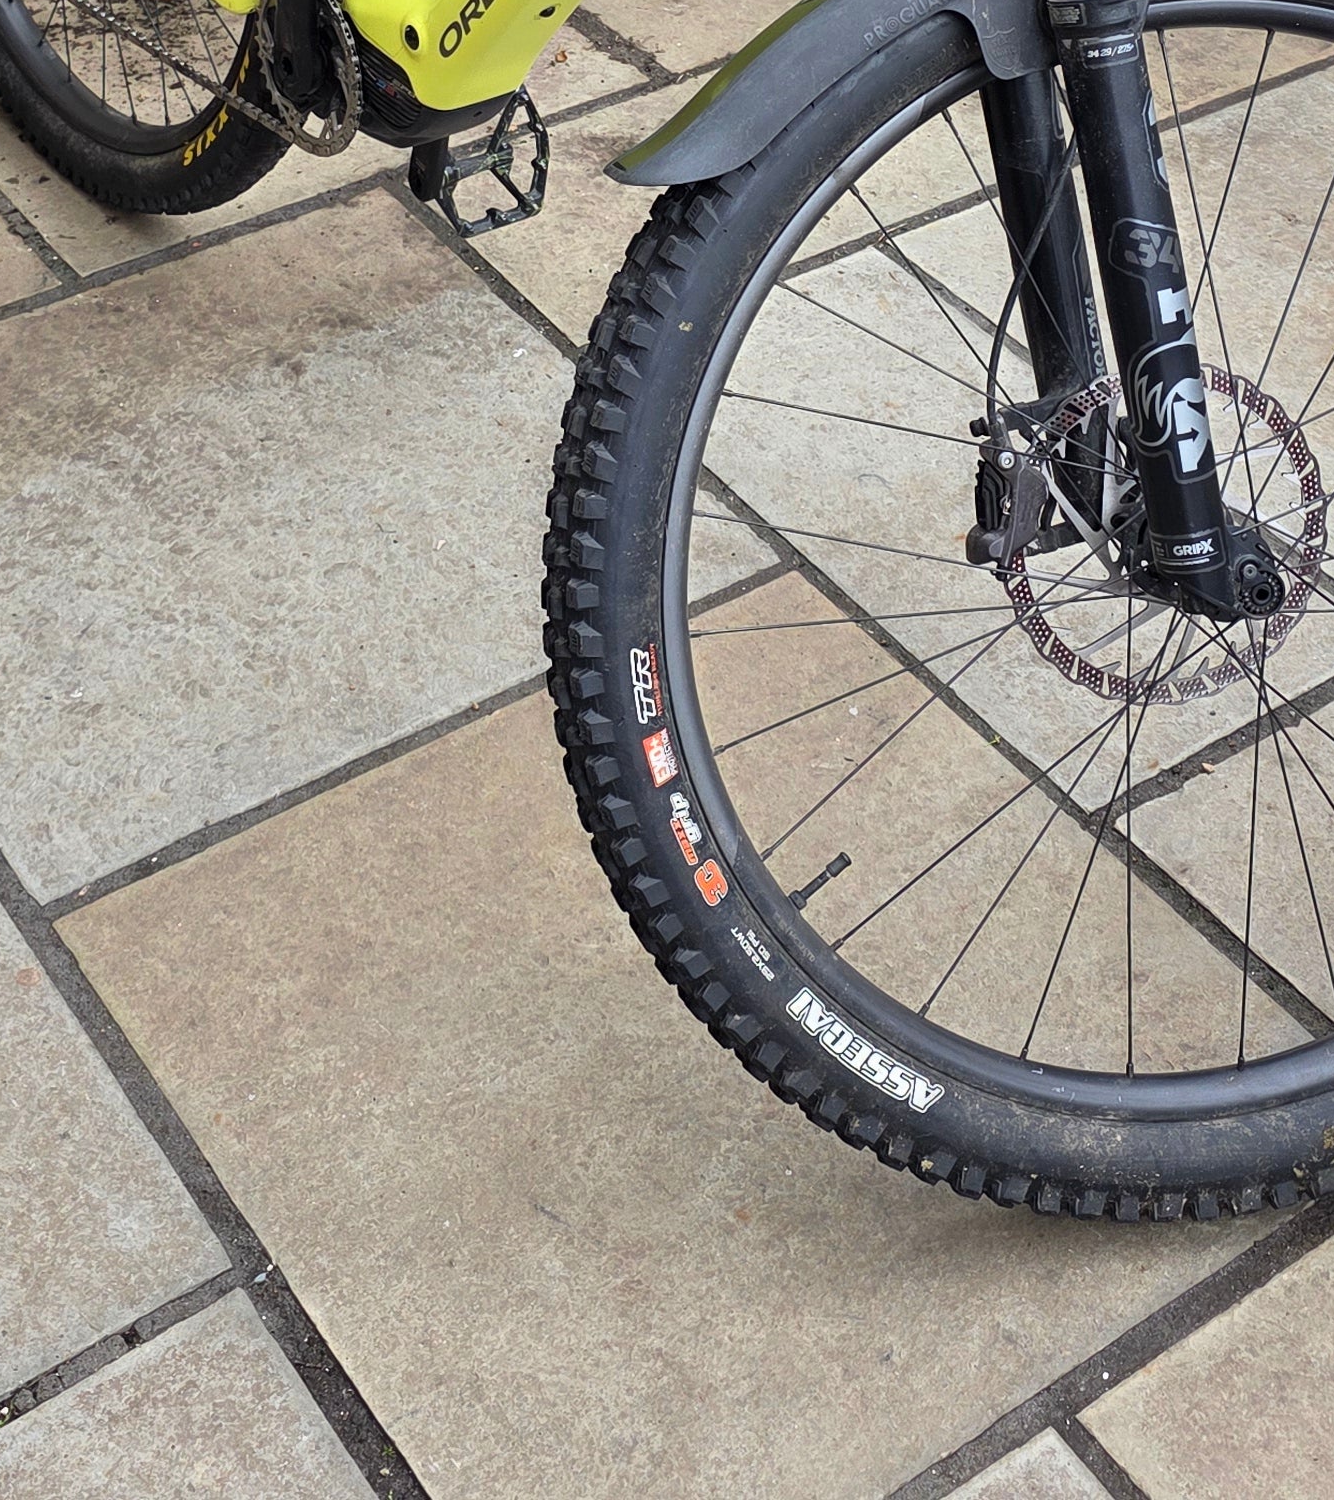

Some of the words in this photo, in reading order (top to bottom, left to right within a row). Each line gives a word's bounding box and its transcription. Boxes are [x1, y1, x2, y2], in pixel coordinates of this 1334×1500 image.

[1123, 228, 1188, 274] 34
[1083, 296, 1106, 378] FACTOR
[1172, 537, 1215, 557] GRIPX
[630, 648, 657, 724] TR
[661, 728, 679, 776] PROTECTION
[670, 792, 702, 845] grip
[786, 986, 945, 1113] ASSEGAI
